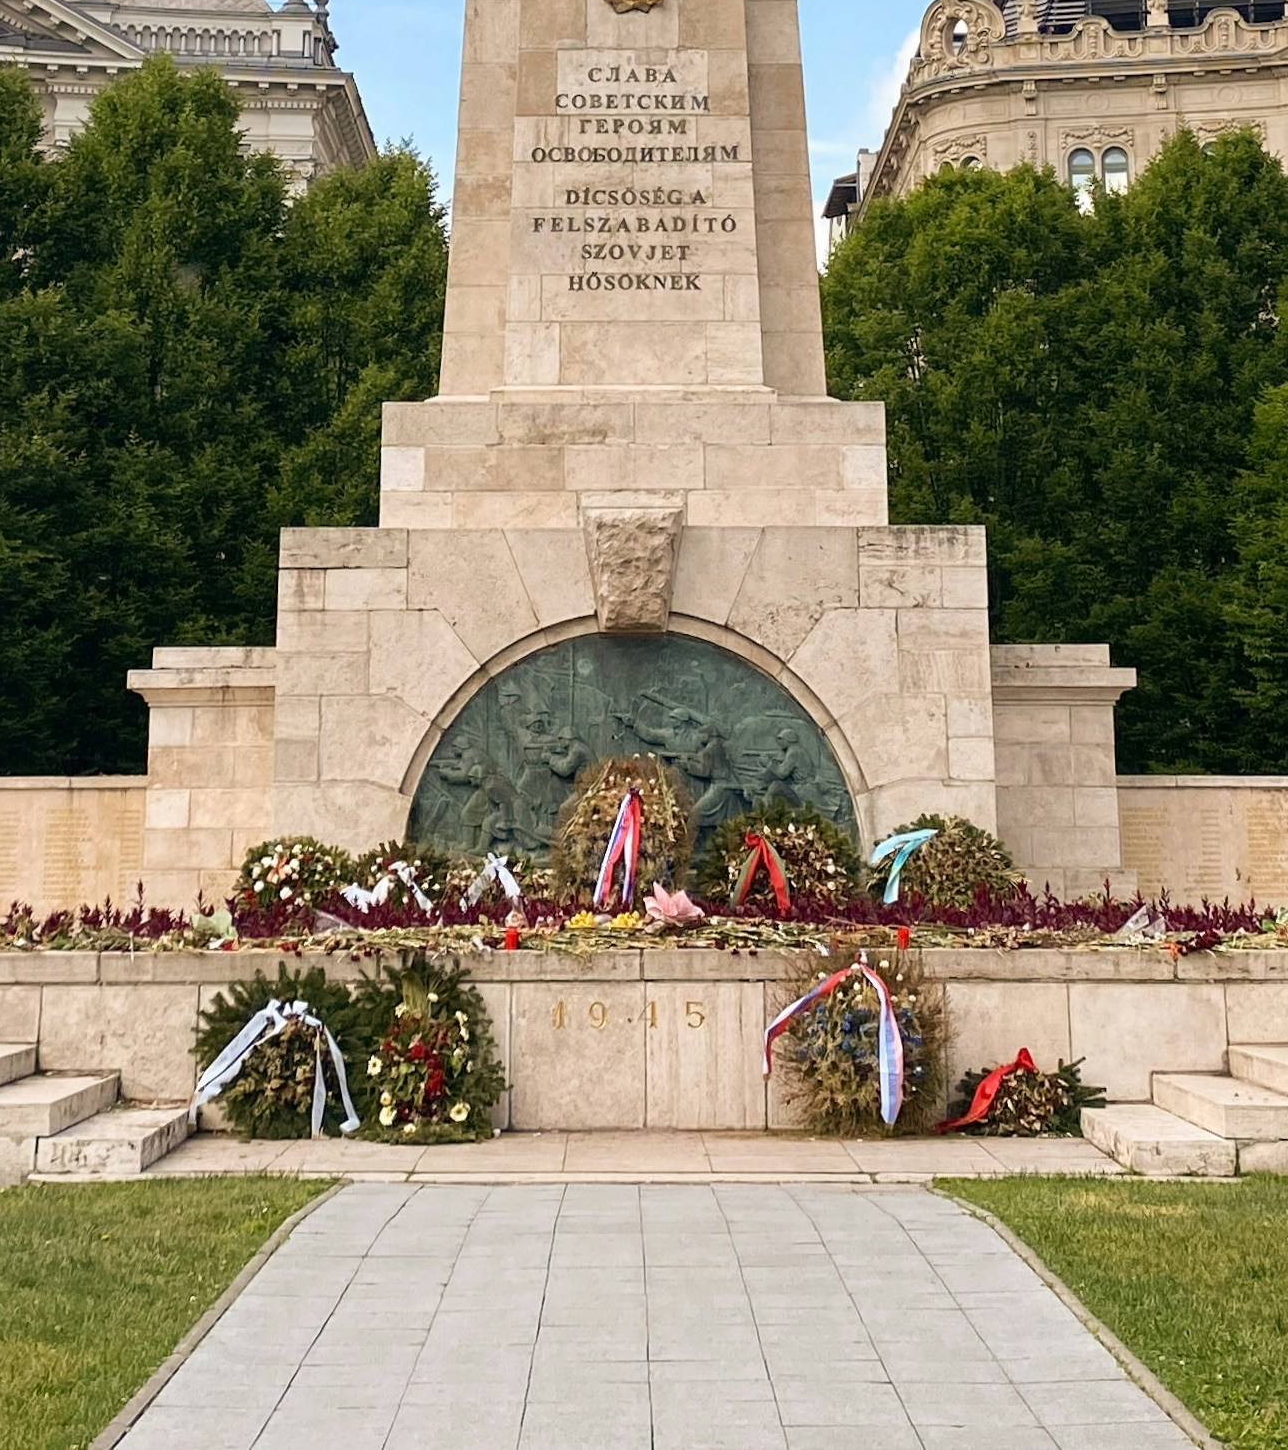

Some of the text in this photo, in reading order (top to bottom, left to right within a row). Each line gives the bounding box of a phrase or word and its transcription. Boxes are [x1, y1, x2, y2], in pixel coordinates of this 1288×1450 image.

[588, 67, 677, 83] СЛАВА
[556, 94, 710, 111] СОВЕТСКИМ
[579, 119, 687, 135] ГЕРОЯМ
[532, 145, 739, 164] ОСВОБОДИТЕЛЯМ
[691, 190, 706, 204] A
[533, 214, 737, 233] FELSZABADÍTÓ
[581, 244, 690, 260] SZOVJET
